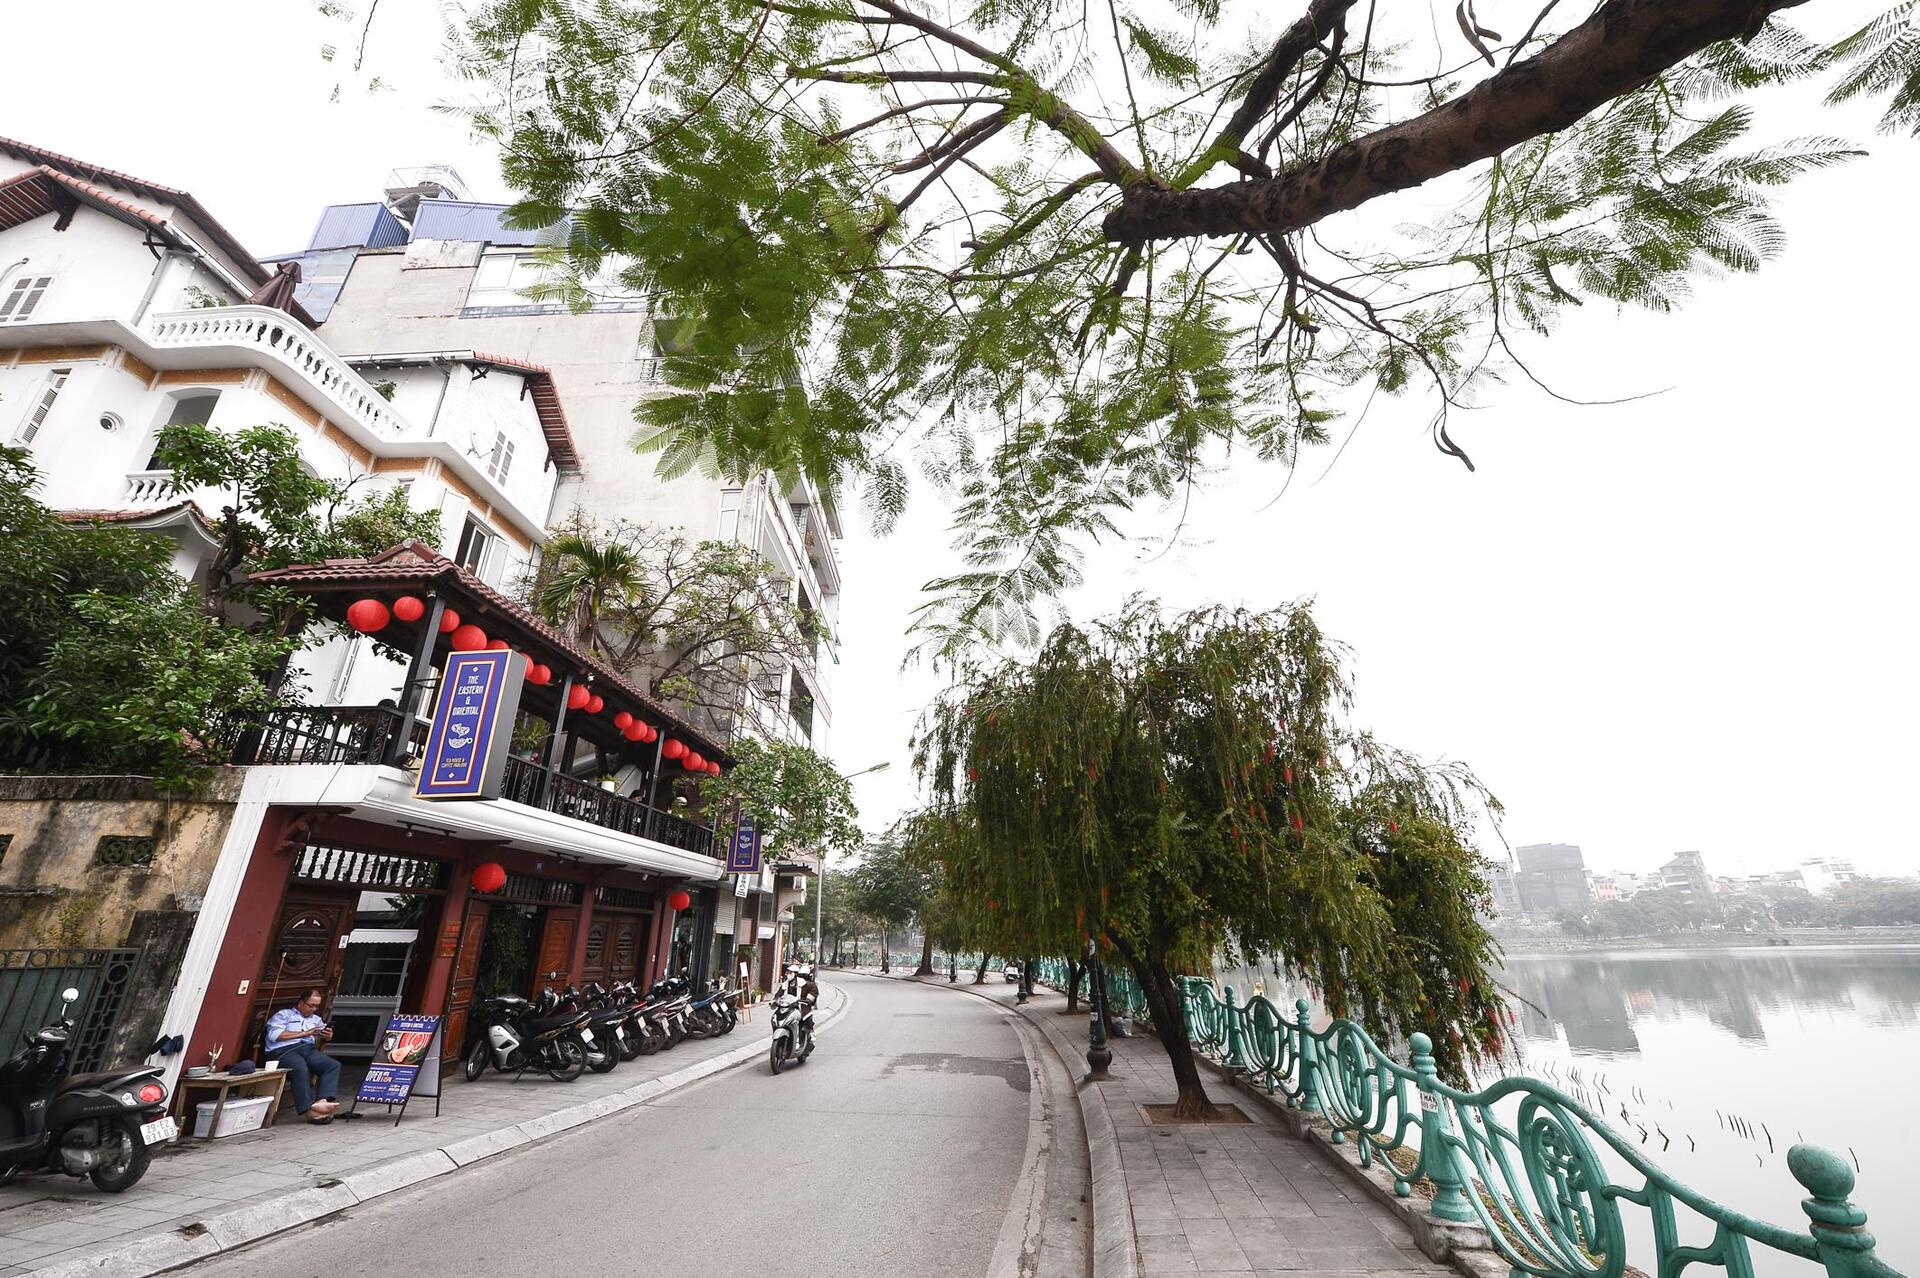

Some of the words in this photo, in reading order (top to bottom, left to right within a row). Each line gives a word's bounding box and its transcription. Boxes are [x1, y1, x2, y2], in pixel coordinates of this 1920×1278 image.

[468, 676, 479, 684] THE
[458, 685, 484, 695] EASTERN
[465, 696, 470, 705] &
[452, 706, 479, 716] ORIENTAL
[365, 1070, 383, 1082] OPEN
